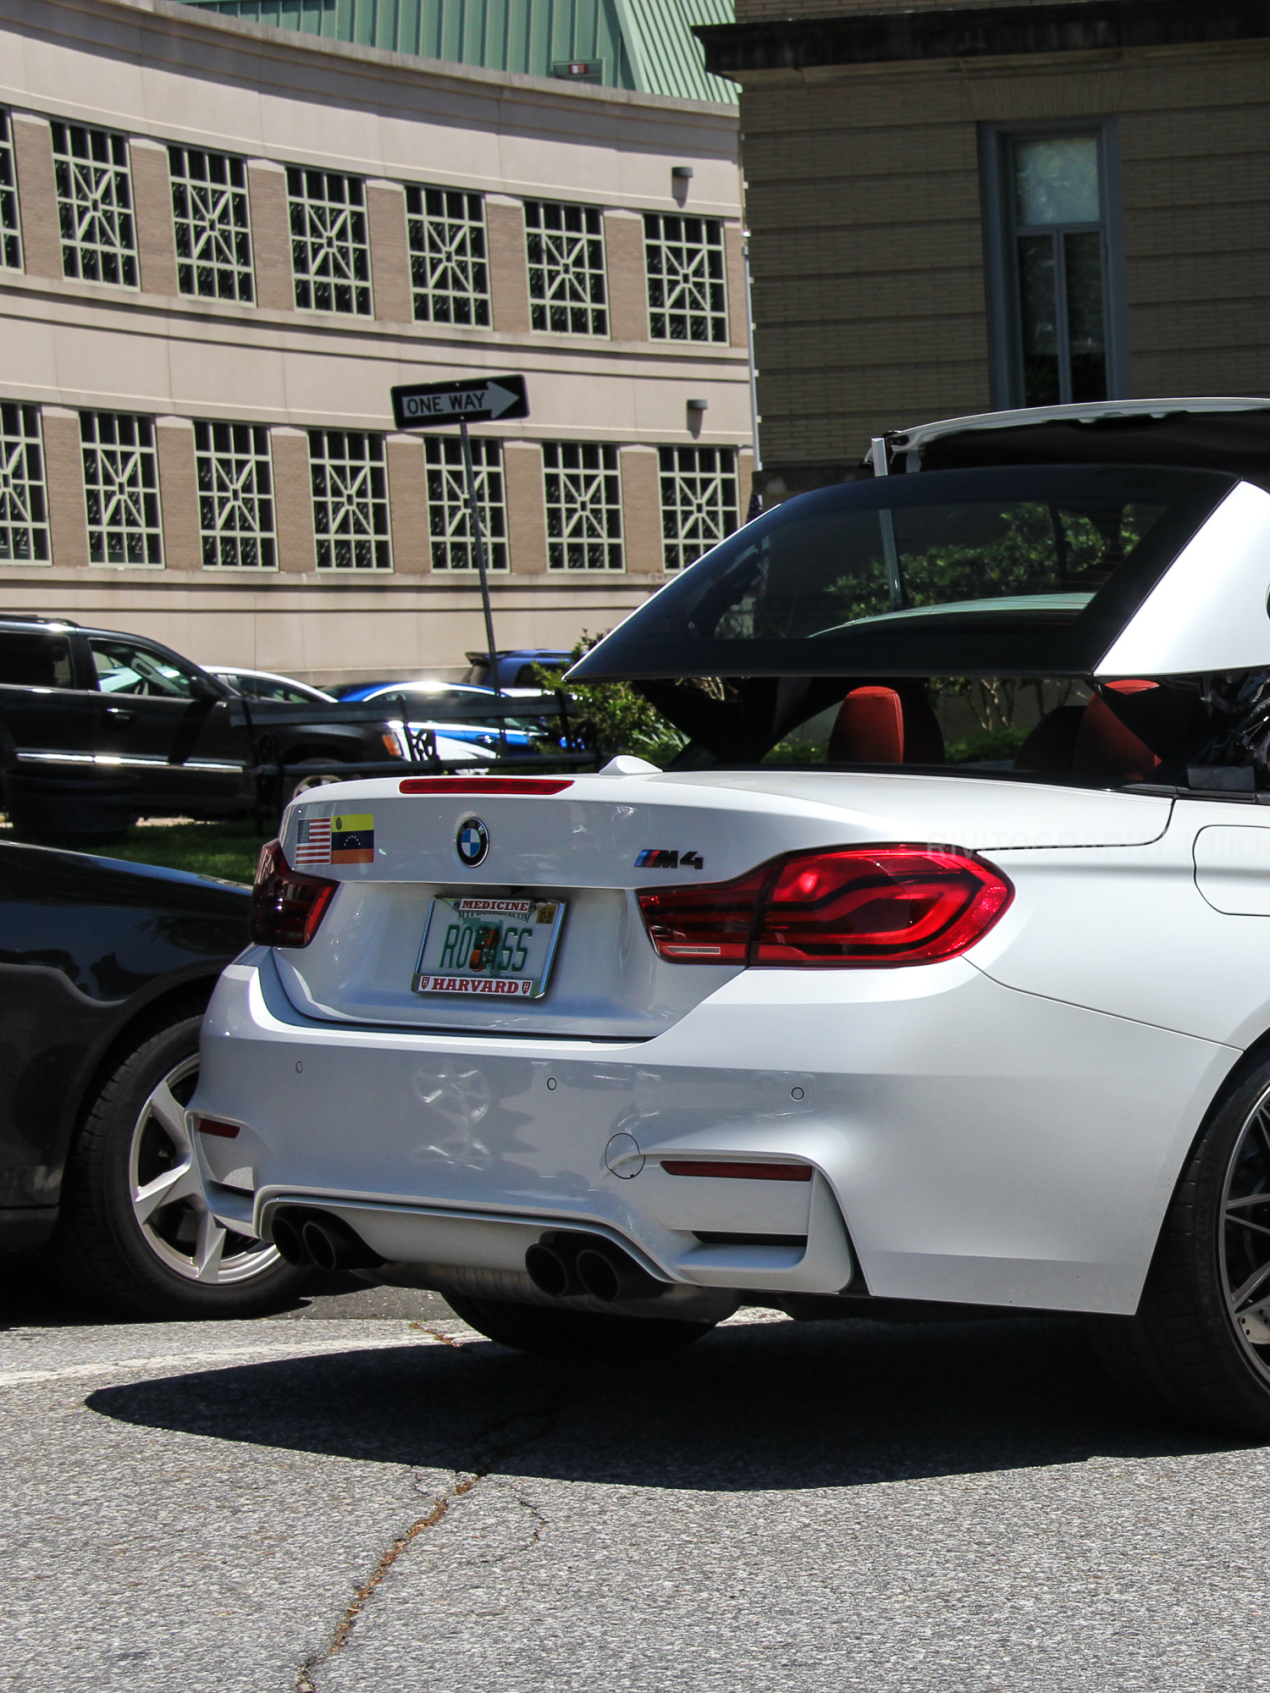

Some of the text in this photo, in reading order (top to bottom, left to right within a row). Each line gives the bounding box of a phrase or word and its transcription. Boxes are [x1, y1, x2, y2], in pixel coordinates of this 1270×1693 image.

[407, 391, 485, 415] ONE WAY
[648, 849, 704, 870] M4
[461, 900, 529, 912] MEDICINE
[431, 977, 519, 994] HARVARD
